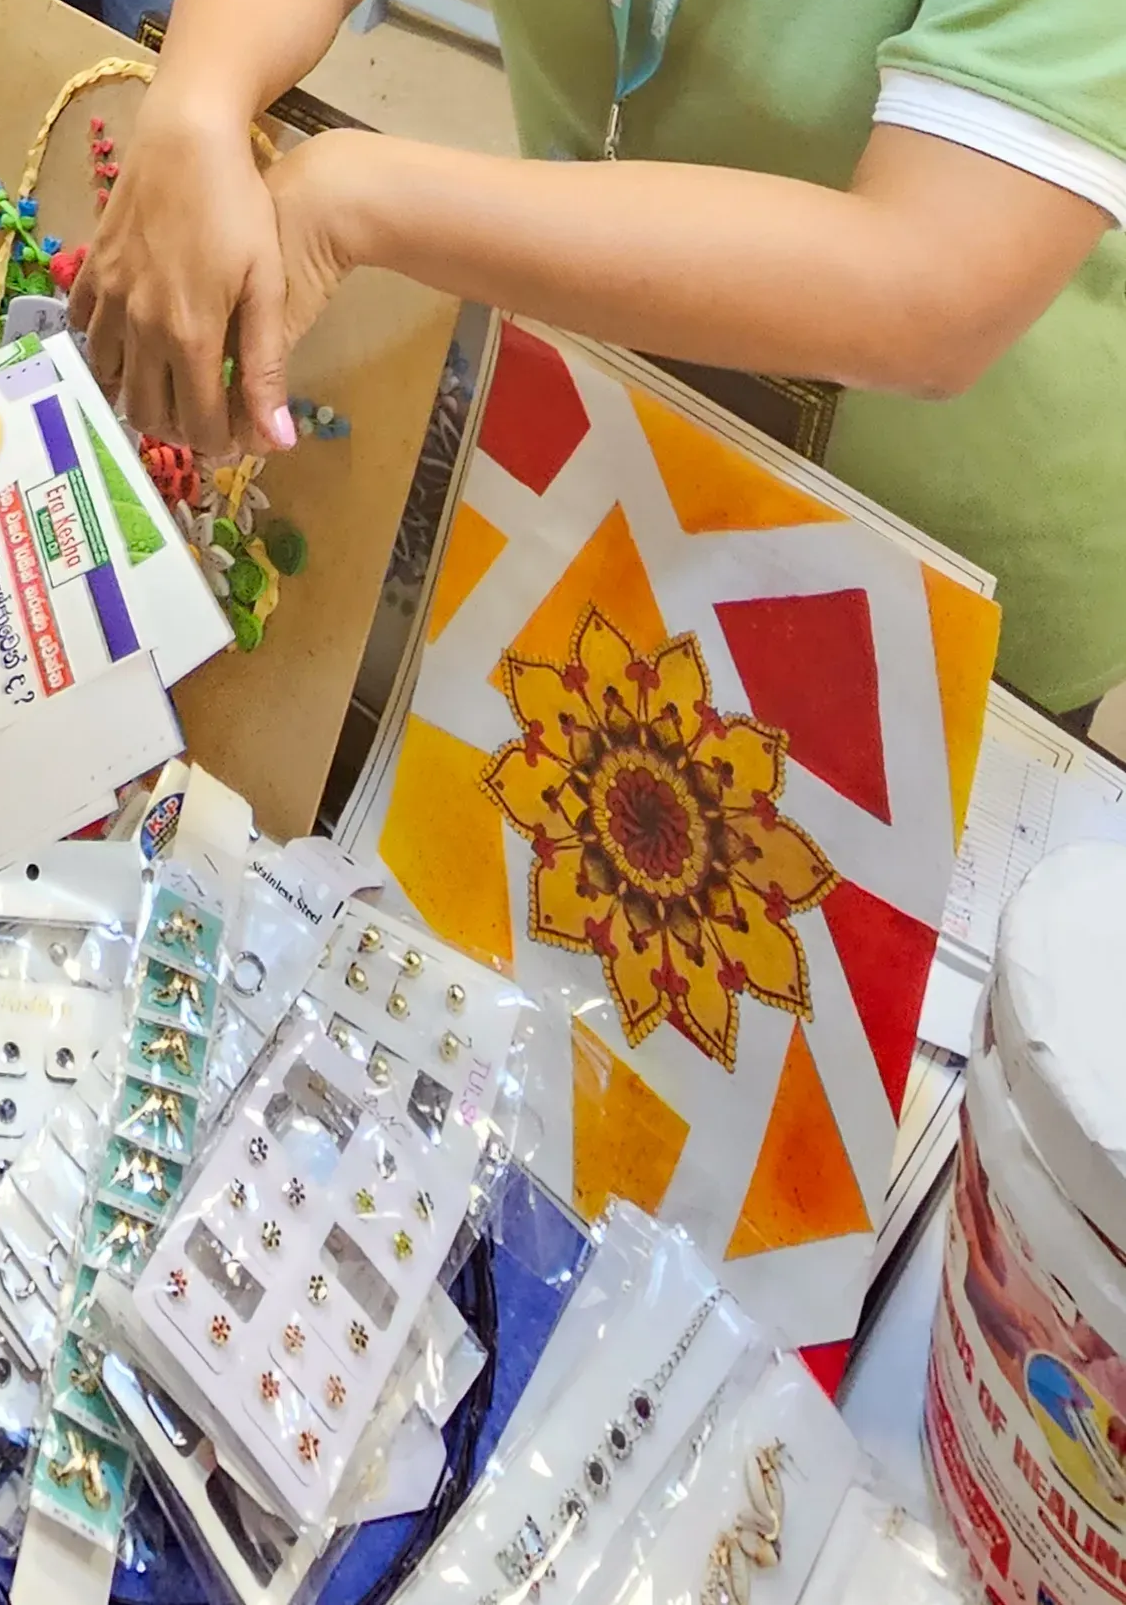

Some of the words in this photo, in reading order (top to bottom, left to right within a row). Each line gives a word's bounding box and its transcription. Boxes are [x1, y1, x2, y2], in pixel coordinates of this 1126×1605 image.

[45, 483, 68, 513] Era
[52, 514, 86, 569] Kesha
[249, 859, 294, 906] Stainless
[296, 897, 324, 926] Steel
[978, 1378, 1008, 1438] OF
